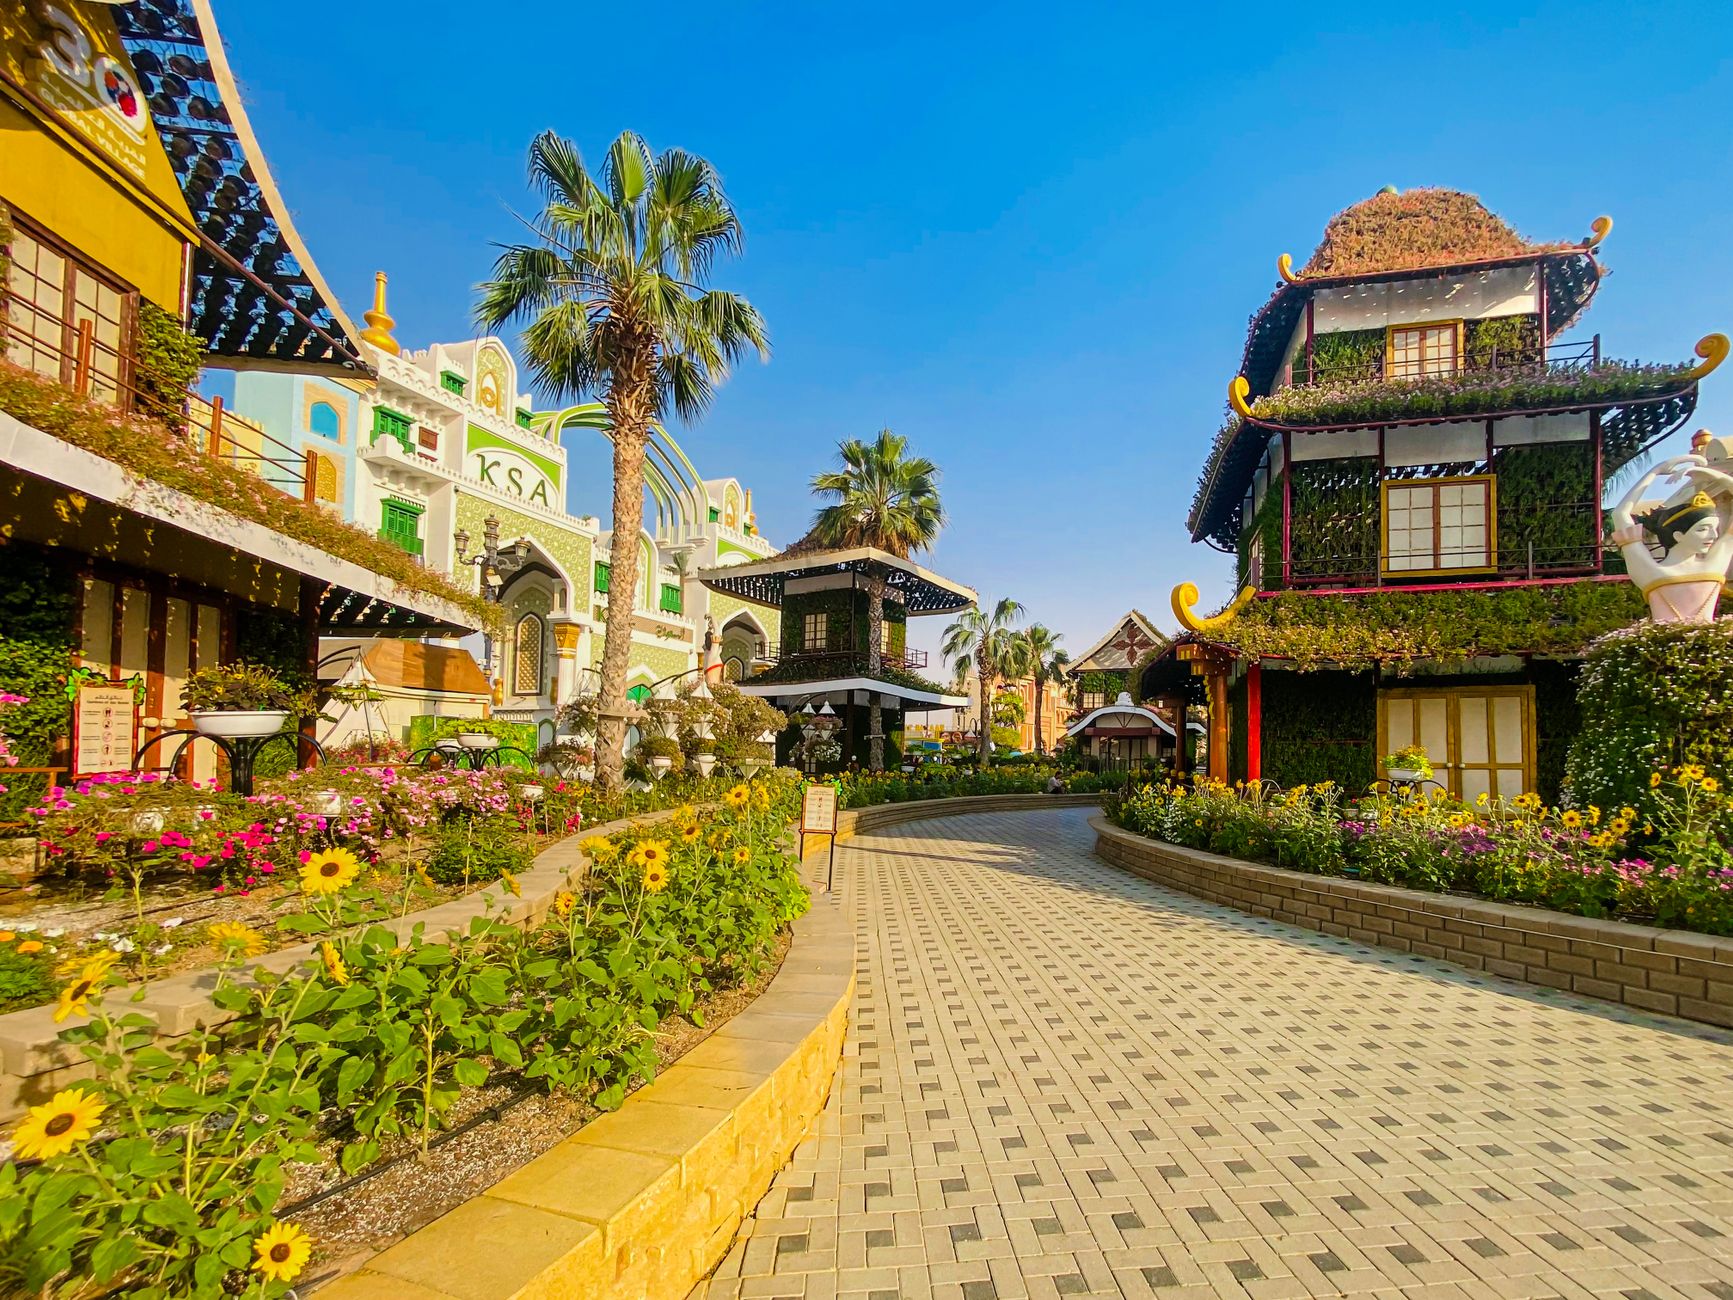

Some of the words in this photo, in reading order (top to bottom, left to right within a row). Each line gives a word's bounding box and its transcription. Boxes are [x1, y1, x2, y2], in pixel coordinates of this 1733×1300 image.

[40, 87, 96, 139] GLOBAL
[96, 133, 145, 180] VILLAGE
[476, 453, 549, 507] KSA
